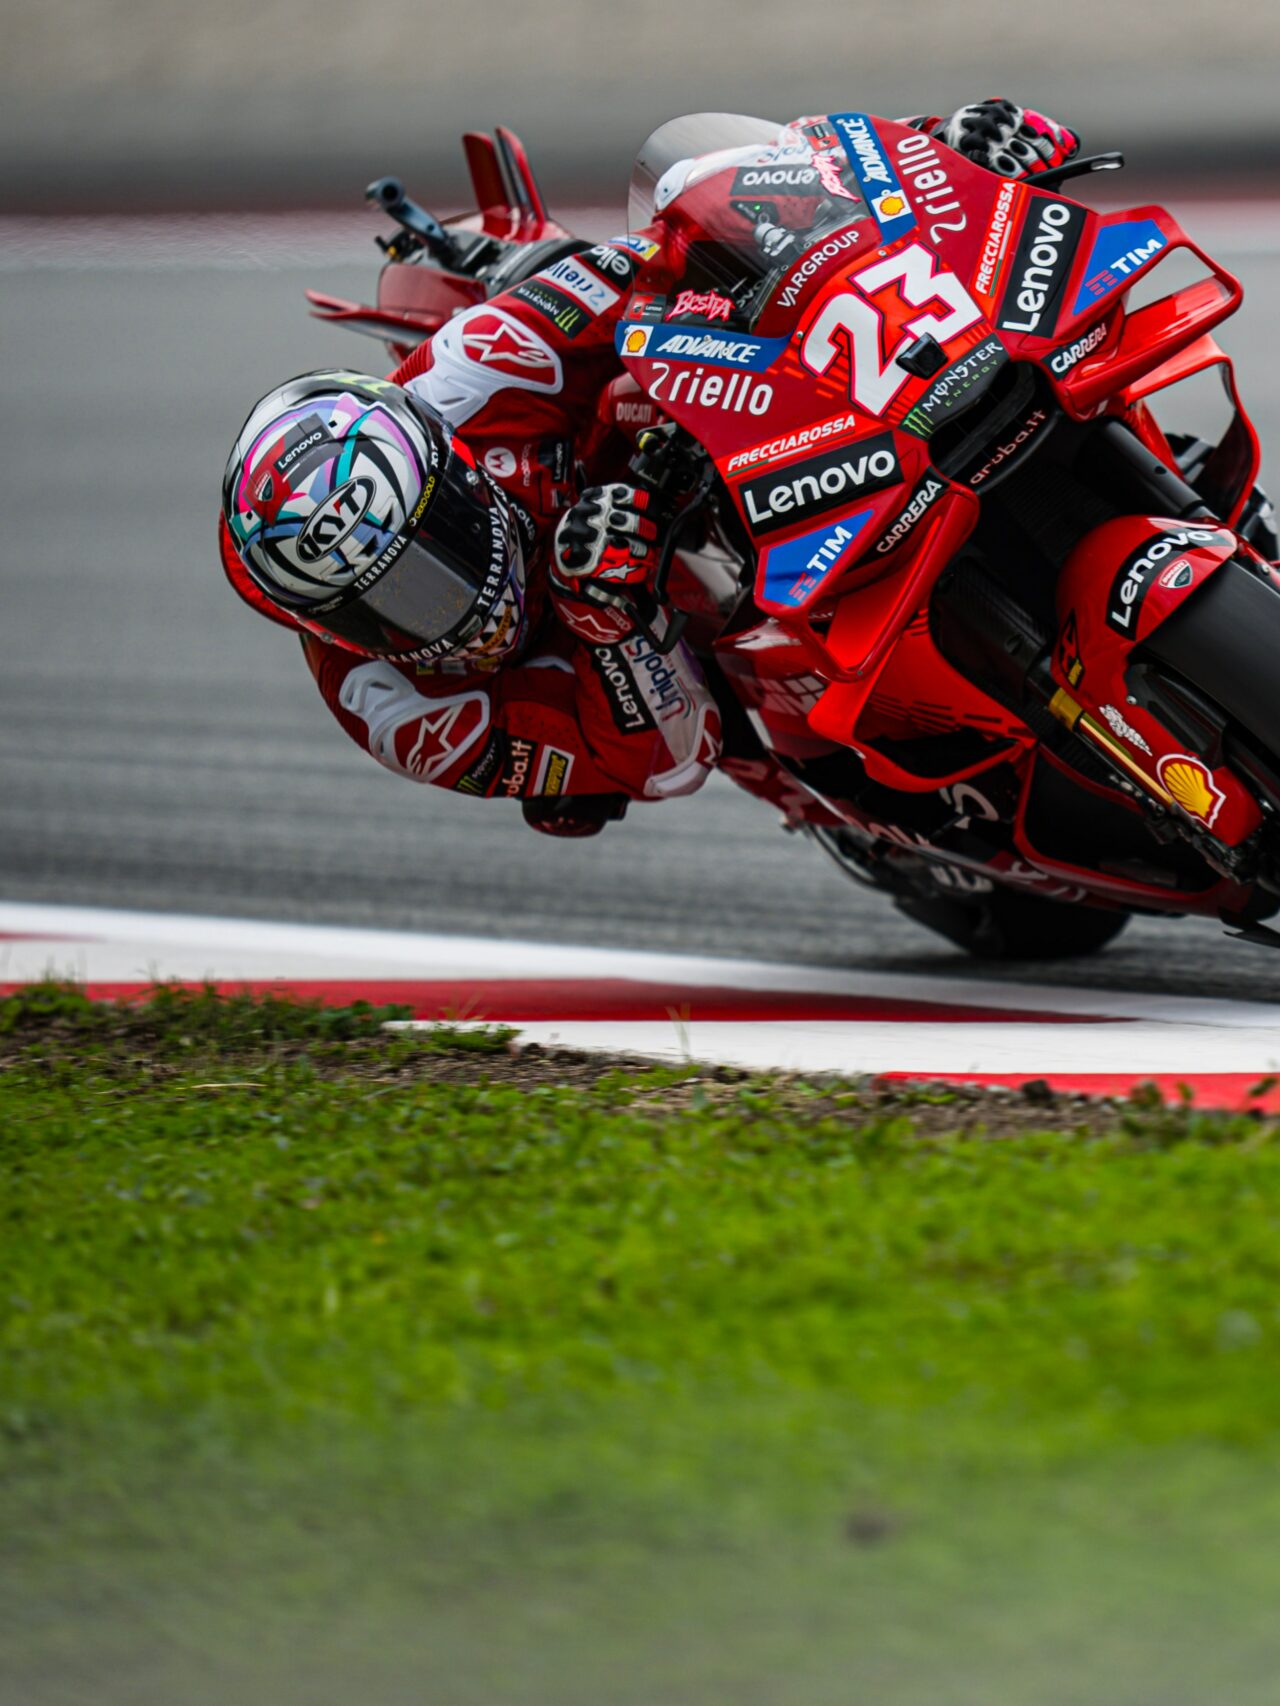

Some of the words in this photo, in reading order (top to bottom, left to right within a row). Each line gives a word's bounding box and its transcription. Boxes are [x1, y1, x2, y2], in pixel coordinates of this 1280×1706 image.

[742, 168, 819, 187] enovo
[842, 117, 892, 183] ADVANCE
[777, 230, 860, 308] VARGROUP
[975, 182, 1016, 295] FRECCIAROSSA
[1002, 202, 1071, 332] Lenovo
[1111, 238, 1163, 275] TIM
[656, 335, 760, 365] ADVANCE
[802, 242, 984, 417] 23
[1050, 323, 1107, 374] CARRERA
[923, 341, 1003, 413] MONSTER
[945, 359, 999, 408] ENERGY
[616, 402, 651, 423] DUCATI
[727, 415, 856, 472] FRECCIAROSSA
[278, 431, 322, 469] Lenovo
[300, 480, 361, 561] KYT
[744, 450, 896, 524] Lenovo
[876, 479, 943, 553] CARRERA
[354, 534, 407, 591] TERRANOVA
[478, 507, 503, 608] TERRANOVA
[807, 526, 852, 573] TIM
[1111, 529, 1213, 628] Lenovo
[597, 648, 645, 729] Lenovo
